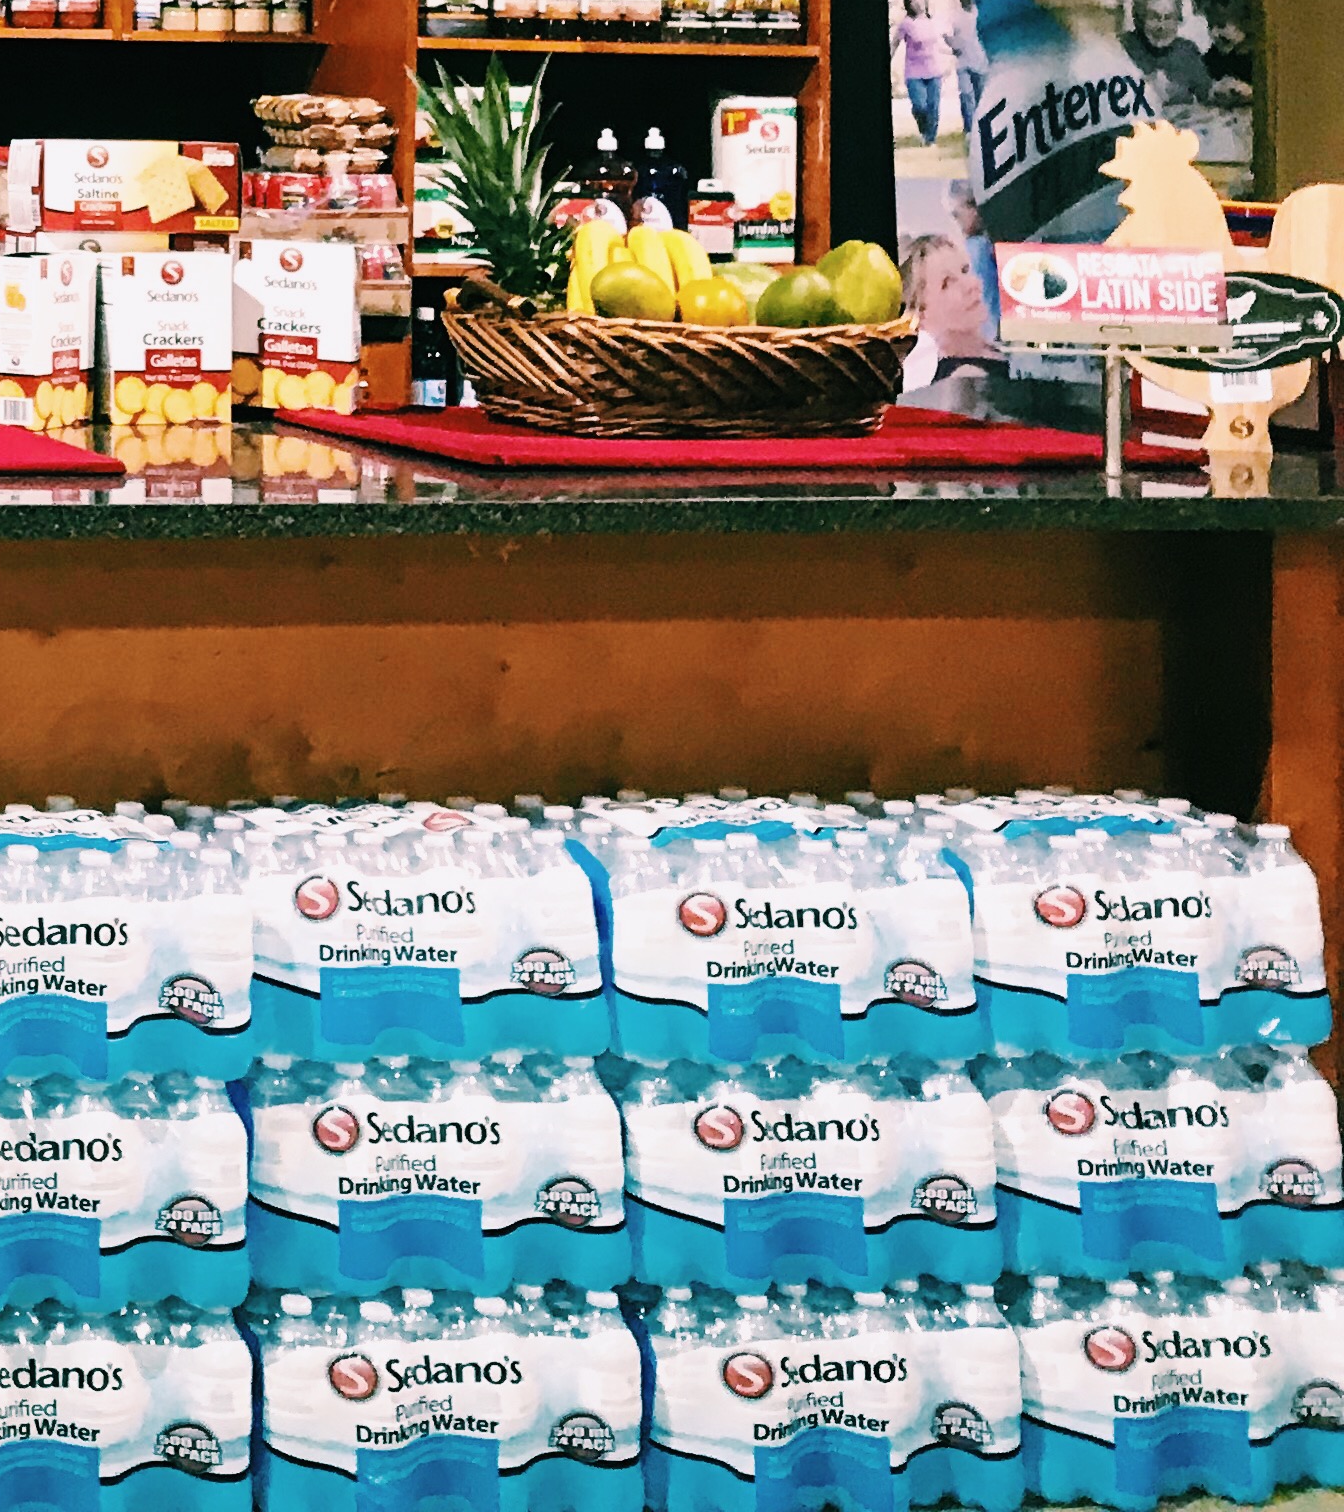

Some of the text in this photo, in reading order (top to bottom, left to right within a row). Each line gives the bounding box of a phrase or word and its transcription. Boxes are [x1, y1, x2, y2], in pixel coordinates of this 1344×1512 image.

[977, 72, 1156, 191] Enterex
[77, 188, 119, 200] Saltine
[1077, 278, 1219, 313] LATIN SIDE
[257, 317, 322, 335] Crackers
[142, 333, 205, 347] Crackers
[263, 338, 315, 356] Galletas
[149, 352, 198, 370] Galletas
[319, 944, 458, 966] Drinking Water
[774, 957, 840, 978] Water
[43, 974, 108, 998] Water
[338, 1174, 481, 1196] Drinking Water
[35, 1190, 102, 1215] Water
[34, 1419, 101, 1442] Water
